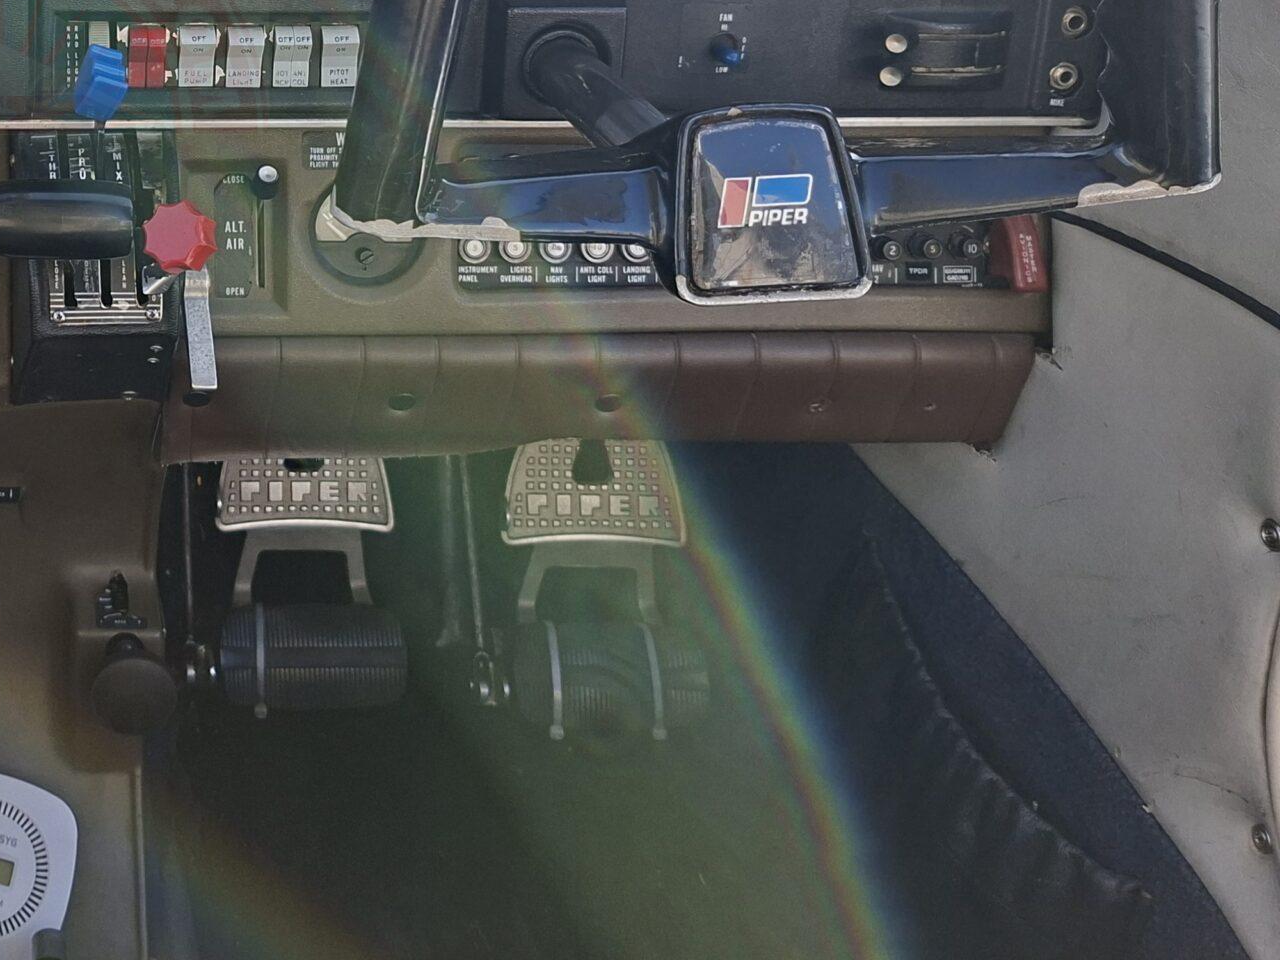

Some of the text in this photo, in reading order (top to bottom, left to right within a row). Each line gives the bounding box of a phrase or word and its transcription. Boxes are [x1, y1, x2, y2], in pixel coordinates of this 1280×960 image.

[719, 13, 733, 22] FAN
[329, 69, 350, 77] PITOT
[330, 77, 349, 85] HEAT
[748, 208, 809, 227] PIPER
[224, 221, 247, 233] ALT.
[225, 238, 245, 250] AIR
[458, 266, 532, 274] INSTRUMENT LIGHTS
[622, 266, 651, 274] LANDING
[500, 274, 532, 283] OVERHEAD
[225, 287, 245, 296] OPEN
